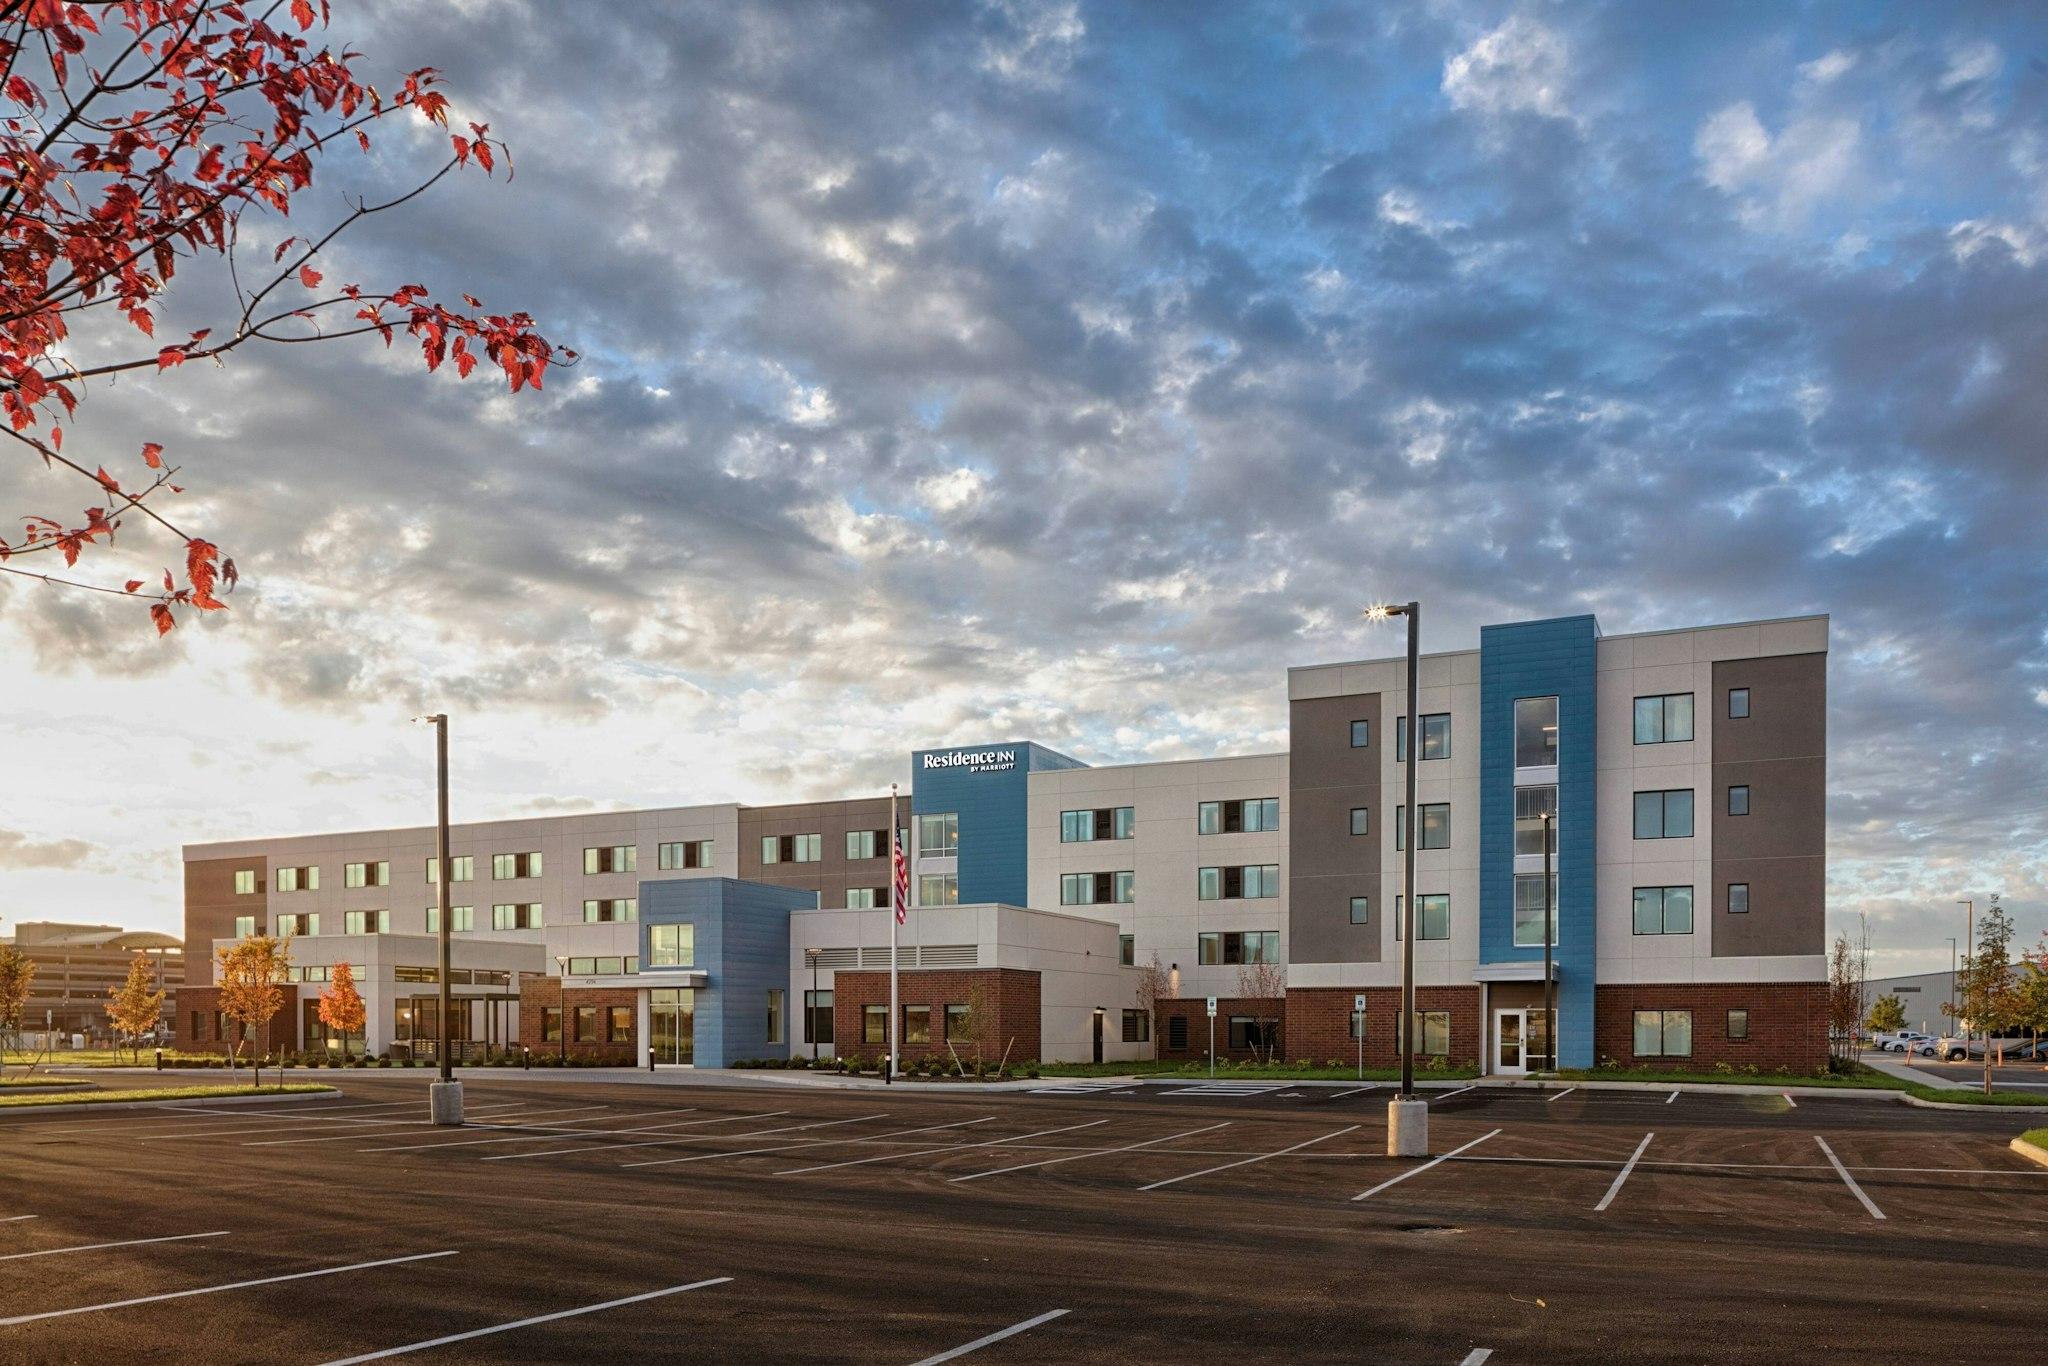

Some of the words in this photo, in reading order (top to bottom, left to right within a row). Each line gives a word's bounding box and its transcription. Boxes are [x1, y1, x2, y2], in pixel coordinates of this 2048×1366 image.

[924, 751, 995, 769] Residence
[997, 750, 1015, 762] INN
[971, 765, 979, 773] BY
[980, 763, 1015, 772] MARRIOTT
